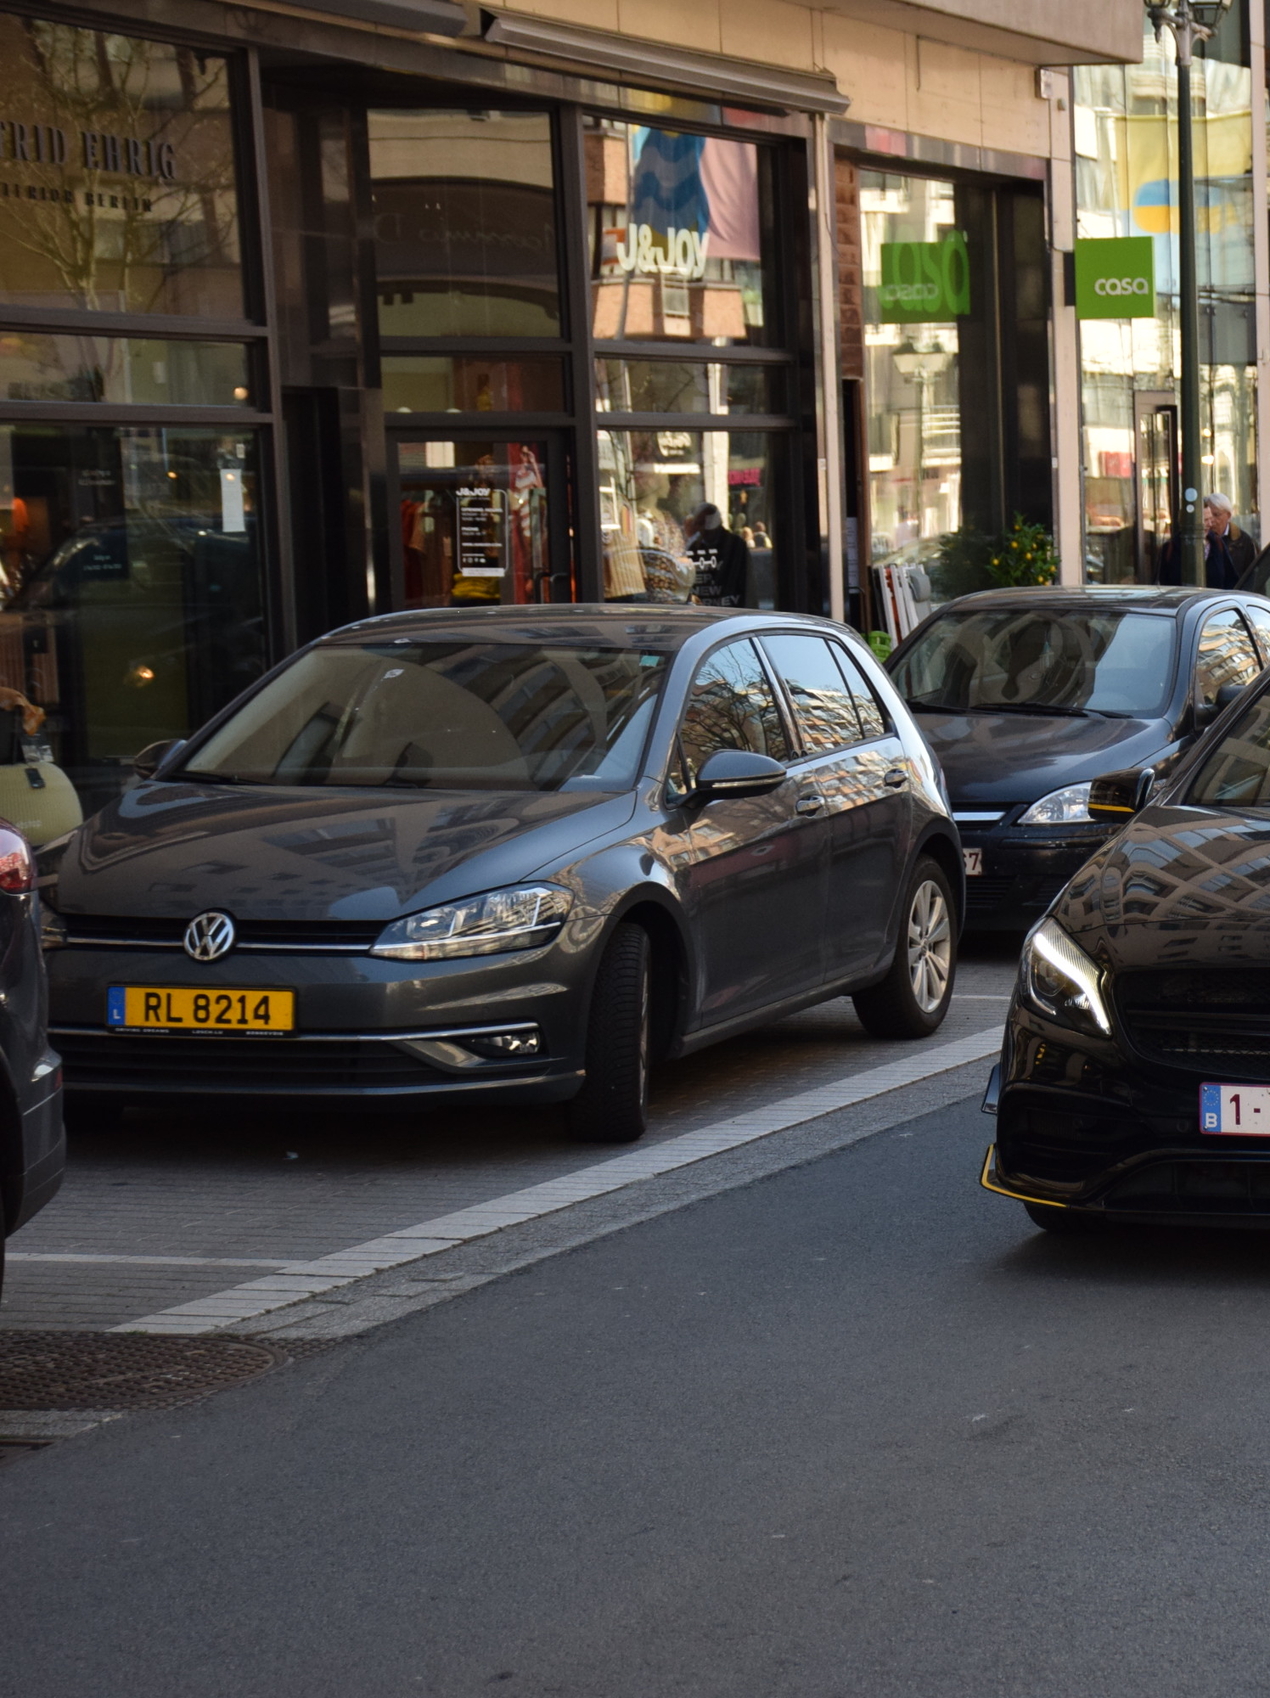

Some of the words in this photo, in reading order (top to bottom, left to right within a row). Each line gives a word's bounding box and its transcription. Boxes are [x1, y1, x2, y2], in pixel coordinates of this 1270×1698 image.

[82, 131, 176, 180] EHRIG
[85, 191, 151, 213] BERLIN
[616, 222, 709, 279] J&JOY
[1094, 276, 1149, 296] casa
[144, 992, 183, 1023] RL
[193, 994, 271, 1025] 8214
[1205, 1112, 1218, 1128] B
